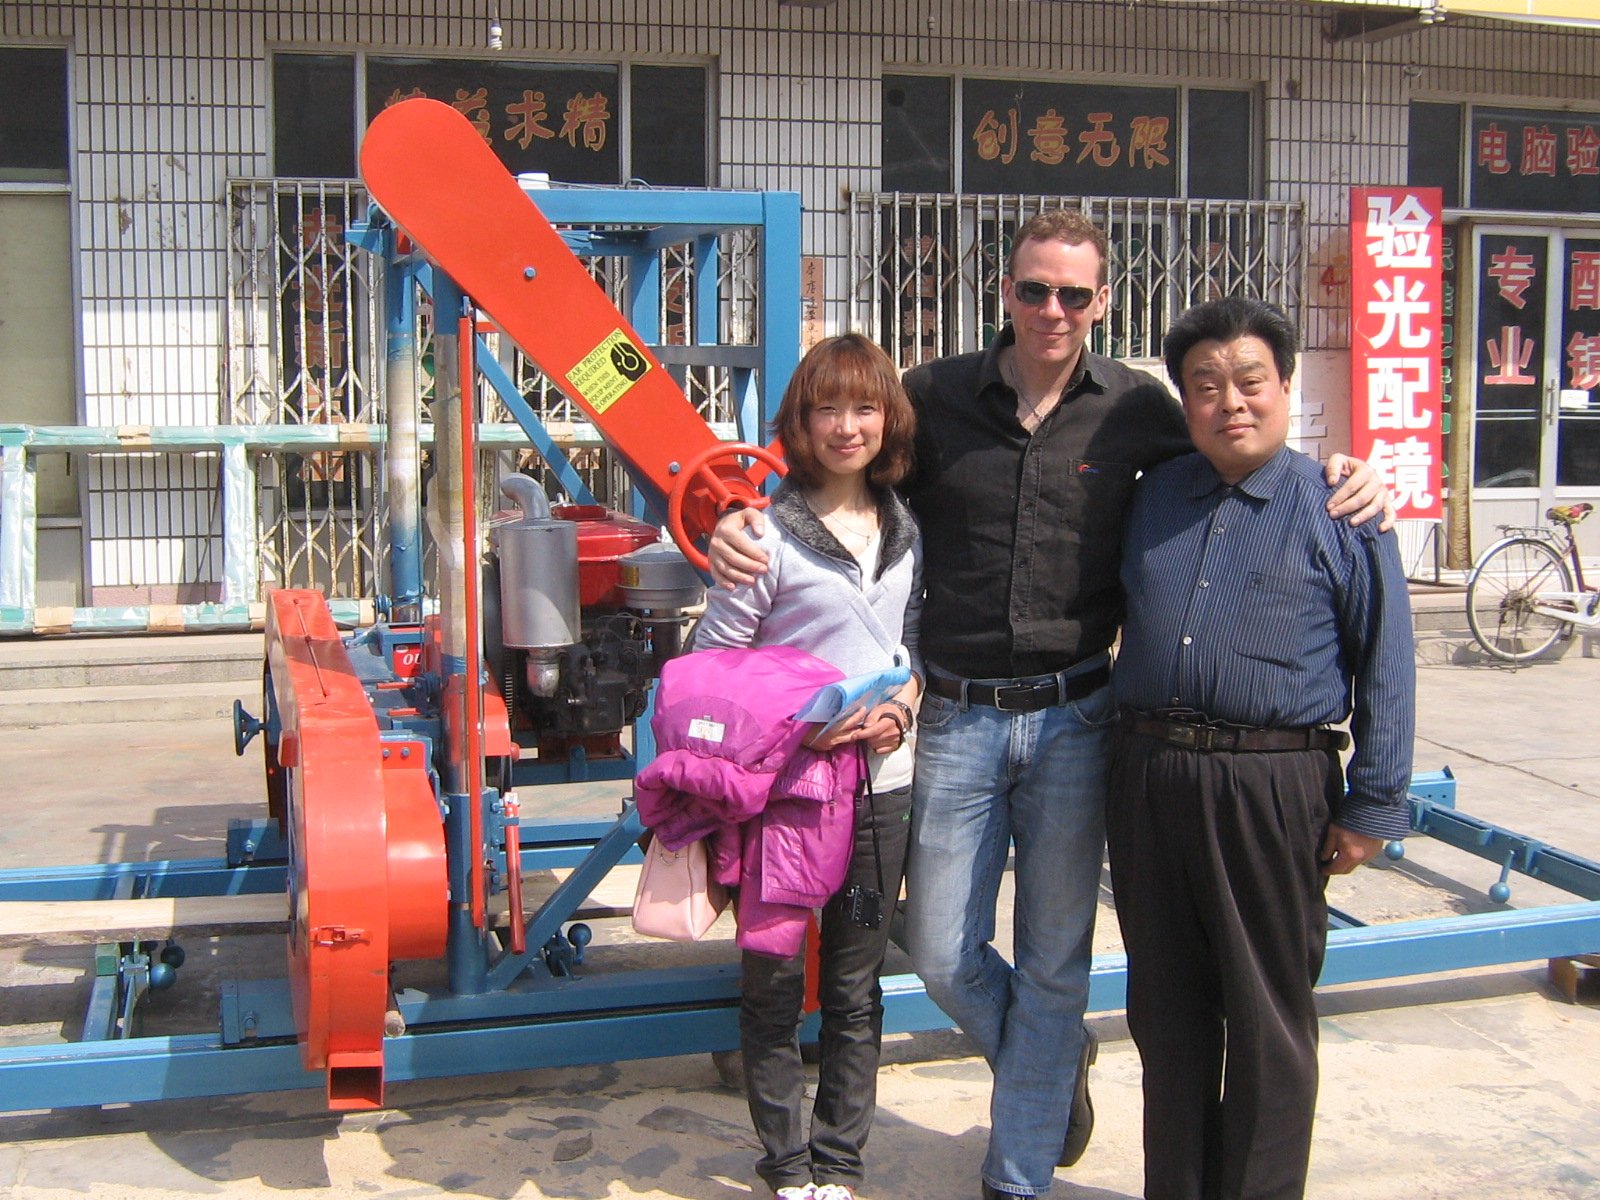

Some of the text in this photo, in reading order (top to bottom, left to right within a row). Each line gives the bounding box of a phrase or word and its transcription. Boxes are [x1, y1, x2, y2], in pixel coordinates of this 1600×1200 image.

[972, 108, 1170, 170] 创意无限
[1484, 246, 1536, 386] 专业
[567, 330, 623, 381] EAR PROTECTION
[573, 356, 607, 388] REQUIRED
[1366, 195, 1433, 509] 验光配镜
[599, 378, 628, 406] OPERATING
